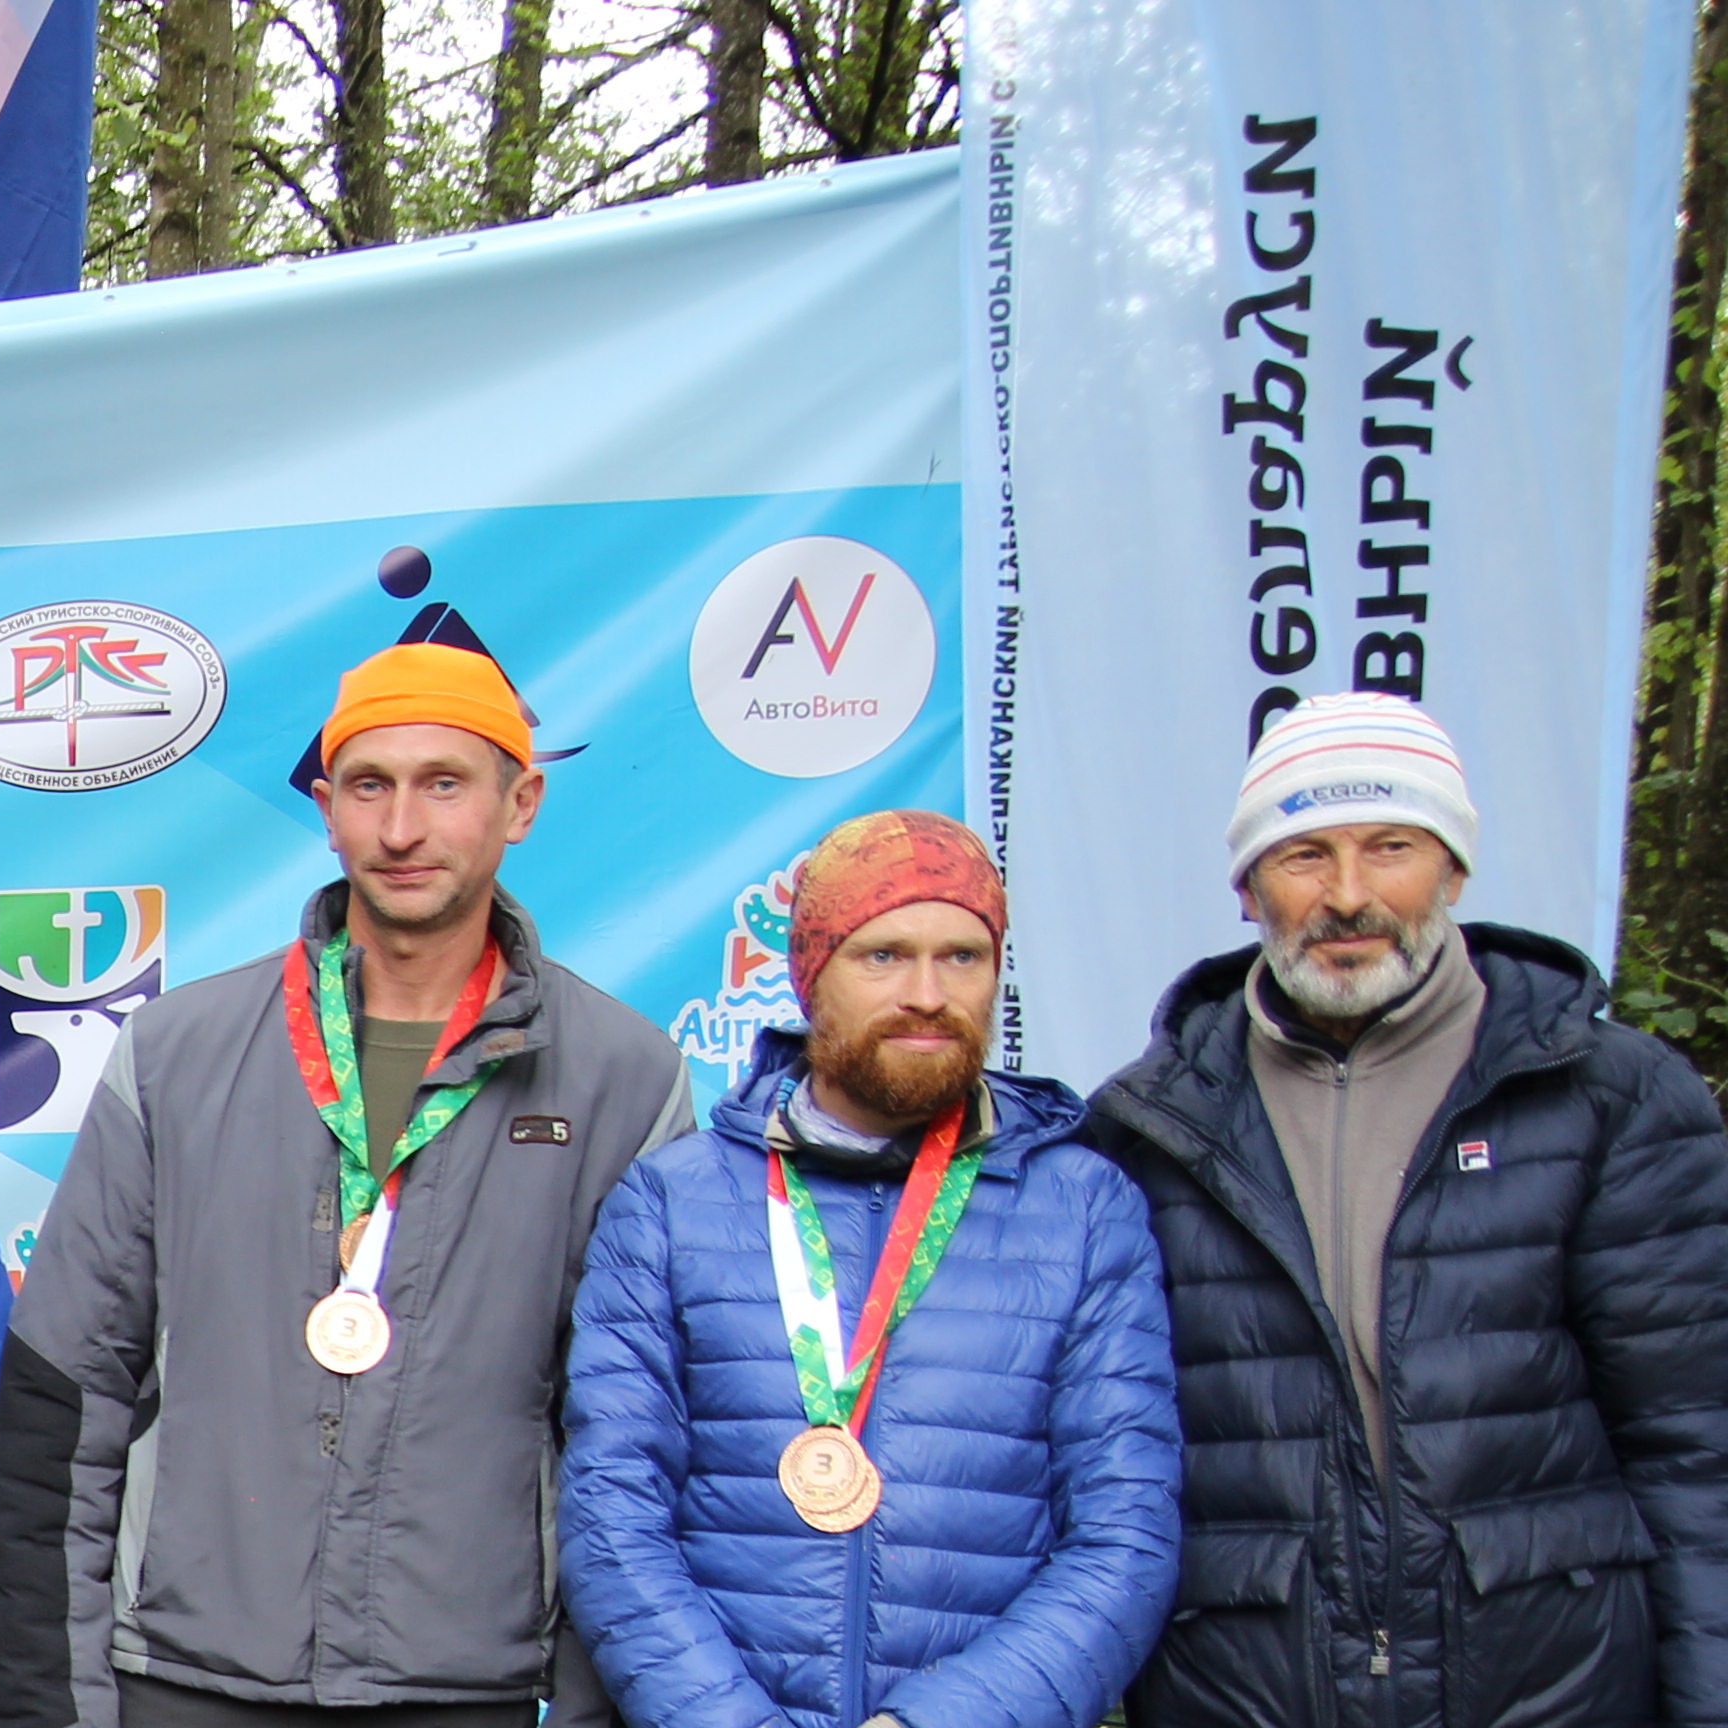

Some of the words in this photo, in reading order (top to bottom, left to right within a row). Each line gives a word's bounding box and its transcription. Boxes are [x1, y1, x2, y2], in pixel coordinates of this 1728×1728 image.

[37, 605, 198, 645] ТУРИСТСКО-СПОРТИВНЫЙ
[744, 695, 879, 721] АвтоВита
[82, 746, 179, 787] ОБЪЕДИНЕНИЕ
[813, 1453, 834, 1476] 3
